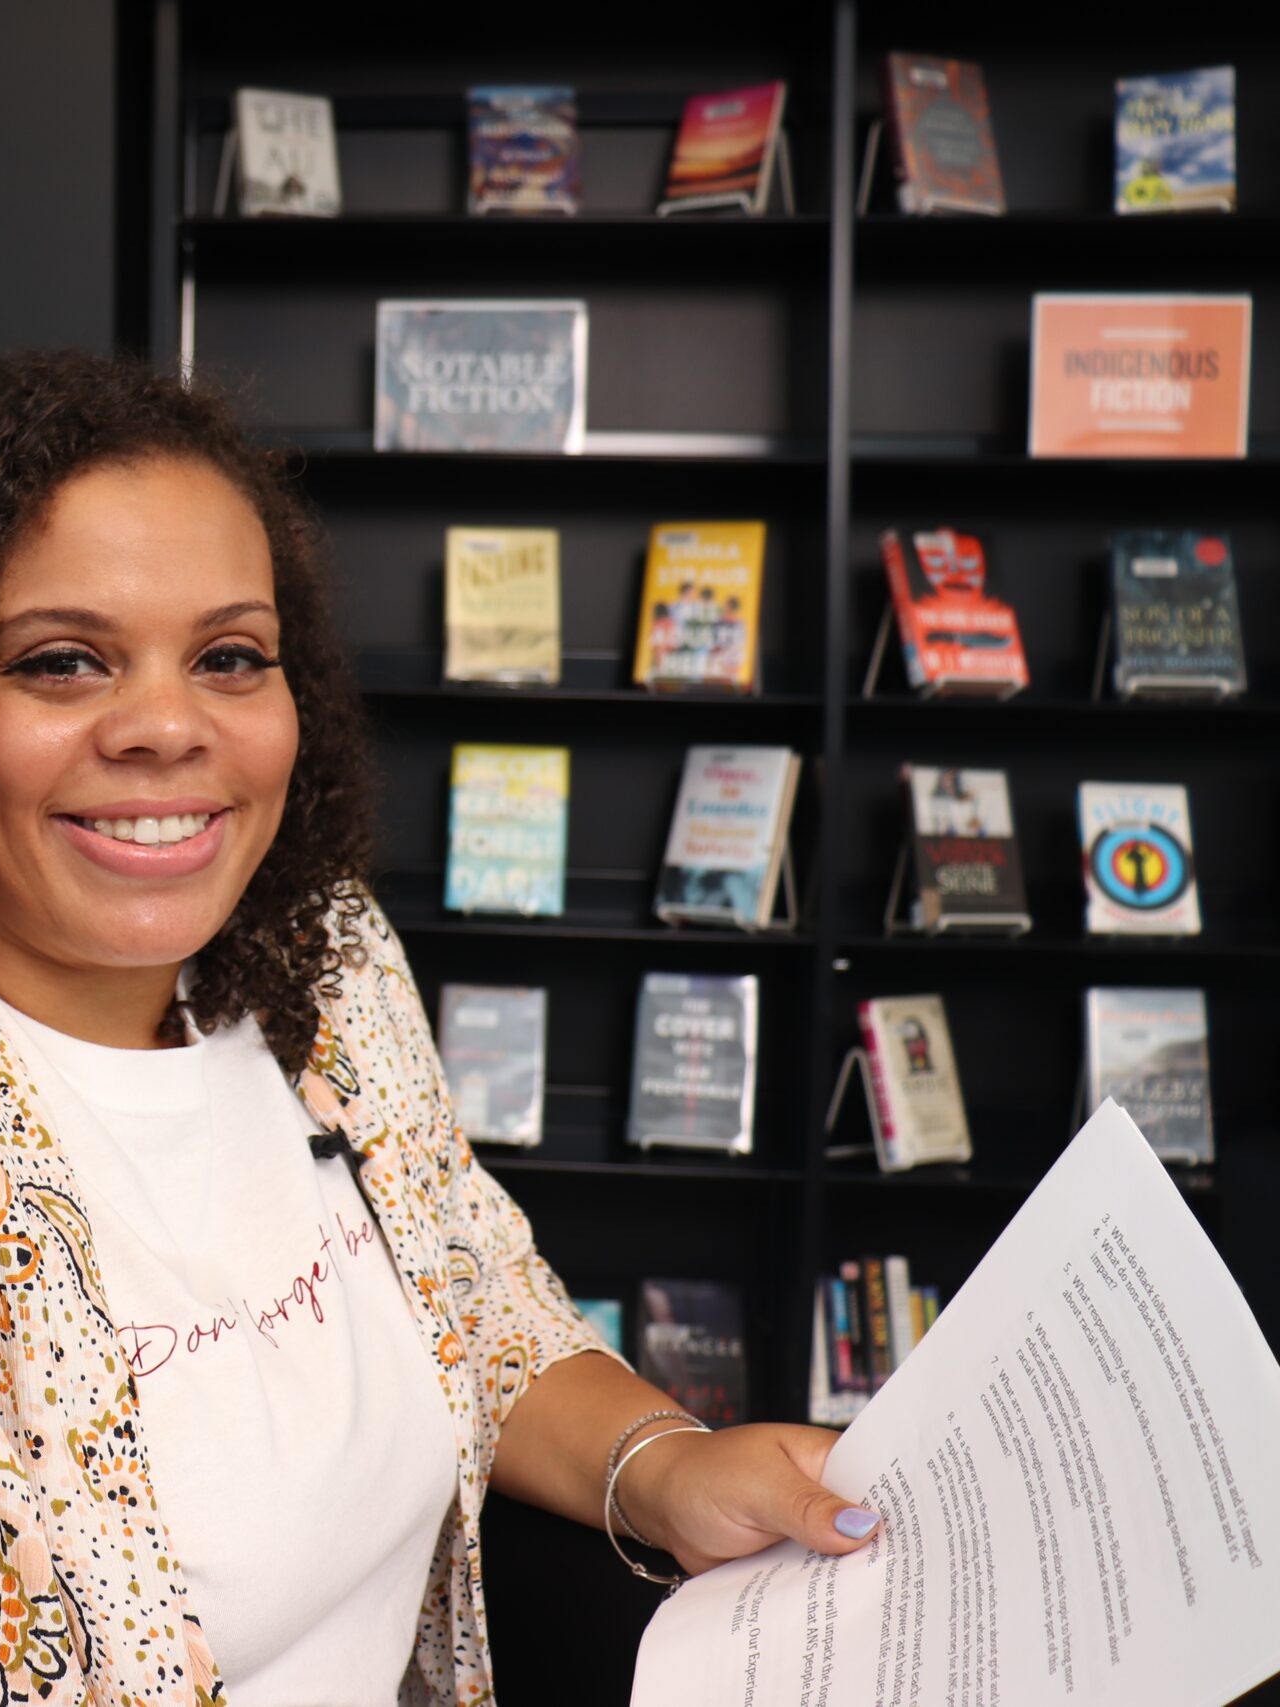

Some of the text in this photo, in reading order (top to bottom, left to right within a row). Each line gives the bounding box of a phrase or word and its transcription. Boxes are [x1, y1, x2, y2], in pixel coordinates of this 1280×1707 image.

[398, 351, 568, 385] NOTABLE
[1063, 348, 1220, 379] INDIGENOUS
[407, 383, 556, 415] FICTION
[1089, 380, 1192, 413] FICTION
[1092, 798, 1181, 824] FLIGHT
[654, 1013, 736, 1041] COVER
[1092, 1226, 1100, 1239] 4.
[1100, 1212, 1110, 1227] 3.
[1101, 1237, 1120, 1268] What
[1110, 1225, 1129, 1256] What
[1090, 1251, 1117, 1290] impact?
[1116, 1266, 1127, 1282] do
[1126, 1254, 1137, 1269] do
[243, 1223, 343, 1349] forget
[336, 1213, 376, 1257] be
[1135, 1265, 1154, 1297] Black
[1026, 1310, 1034, 1323] 6.
[1124, 1280, 1155, 1331] non-Black
[1150, 1293, 1167, 1321] folks
[1034, 1322, 1051, 1353] What
[1061, 1289, 1117, 1385] about racial trauma?
[1151, 1327, 1167, 1355] folks
[1164, 1319, 1182, 1346] need
[1025, 1336, 1052, 1386] educating
[1176, 1343, 1188, 1358] to
[1062, 1261, 1072, 1276] 5.
[1072, 1274, 1090, 1305] What
[1087, 1303, 1123, 1369] responsibility
[1120, 1368, 1130, 1384] do
[1126, 1381, 1142, 1412] Black
[1135, 1409, 1150, 1437] folks
[1145, 1434, 1158, 1462] have
[1152, 1459, 1162, 1474] in
[1162, 1353, 1180, 1380] need
[1181, 1354, 1198, 1386] know
[1015, 1347, 1035, 1377] racial
[1030, 1374, 1049, 1412] trauma
[1045, 1410, 1059, 1431] and
[1048, 1351, 1081, 1418] accountability
[1172, 1377, 1185, 1392] to
[990, 1354, 999, 1369] 7.
[998, 1368, 1014, 1399] What
[1010, 1397, 1021, 1415] are
[1016, 1413, 1031, 1437] your
[1027, 1436, 1043, 1481] thoughts
[1047, 1382, 1073, 1438] themselves
[1178, 1389, 1194, 1420] know
[980, 1393, 1012, 1458] conversation?
[988, 1382, 1014, 1436] awareness,
[1011, 1434, 1029, 1479] attention
[1077, 1418, 1090, 1439] and
[936, 1447, 952, 1476] racial
[1068, 1436, 1081, 1457] and
[1074, 1454, 1088, 1490] having
[1083, 1437, 1107, 1504] responsibility
[878, 1473, 904, 1526] speaking
[1101, 1504, 1111, 1519] do
[895, 1525, 909, 1554] your
[825, 1577, 835, 1597] we
[889, 1457, 925, 1699] I want to express my gratitude toward each
[900, 1554, 911, 1590] words
[807, 1579, 818, 1600] loss
[875, 1498, 897, 1696] talk about these important life issues
[899, 1589, 911, 1602] of
[730, 1603, 745, 1635] Willis.
[746, 1593, 763, 1650] Story, Our
[806, 1600, 819, 1625] that
[824, 1597, 837, 1620] will
[896, 1601, 907, 1637] power
[805, 1627, 818, 1651] ANS
[822, 1621, 834, 1662] unpack
[895, 1638, 907, 1662] and
[800, 1651, 814, 1691] people
[820, 1662, 833, 1682] the
